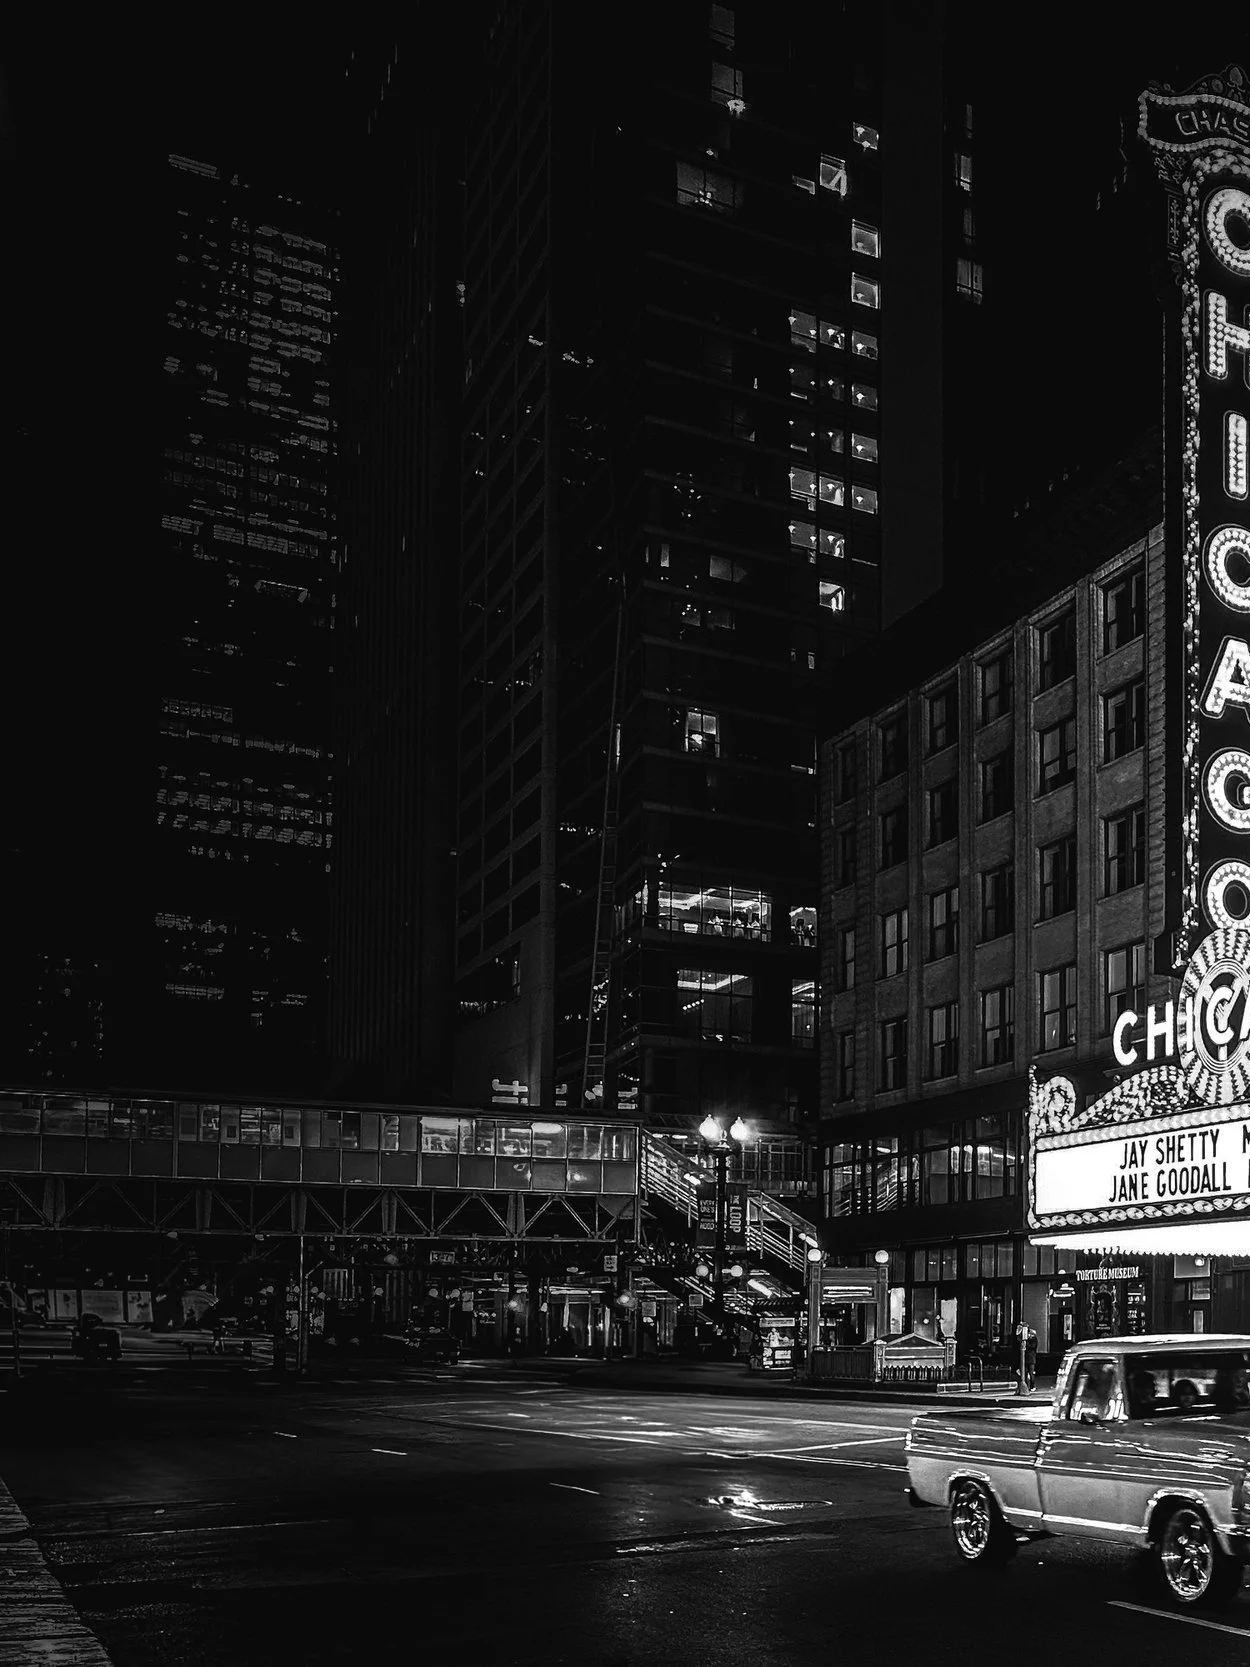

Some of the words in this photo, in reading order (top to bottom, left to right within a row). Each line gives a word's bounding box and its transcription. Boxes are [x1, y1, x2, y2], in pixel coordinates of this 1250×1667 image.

[1120, 1140, 1149, 1170] JAY
[1155, 1129, 1220, 1165] SHETTY
[1109, 1172, 1149, 1203] JANE
[1156, 1161, 1232, 1198] GOODALL
[729, 1206, 742, 1233] LOOP
[1076, 1269, 1108, 1281] TORTURE
[1108, 1266, 1139, 1279] MUSEUM
